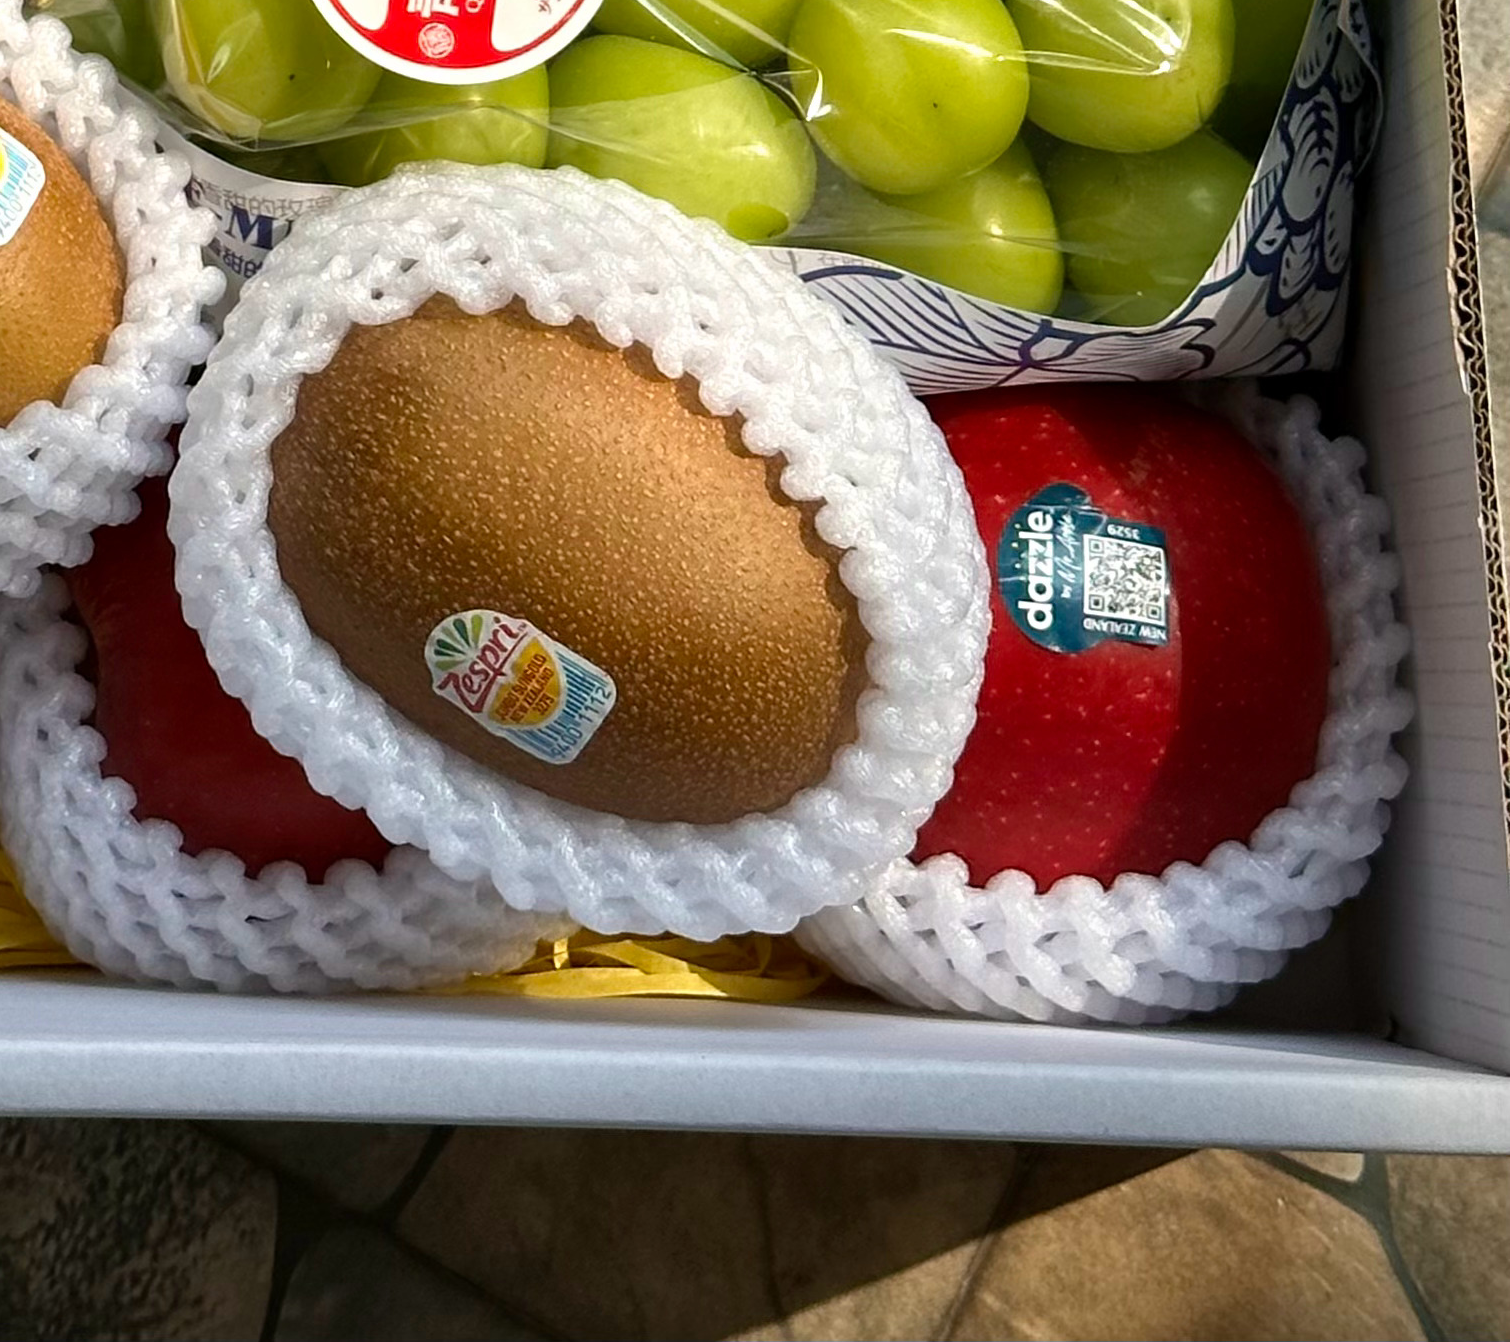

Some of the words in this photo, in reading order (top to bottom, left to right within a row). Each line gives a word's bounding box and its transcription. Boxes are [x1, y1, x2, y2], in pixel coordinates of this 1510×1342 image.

[1018, 511, 1054, 631] dazzle
[1083, 617, 1137, 637] ZEALAND
[1139, 627, 1167, 640] NEW
[437, 615, 529, 713] Zespri
[579, 686, 612, 724] 1112
